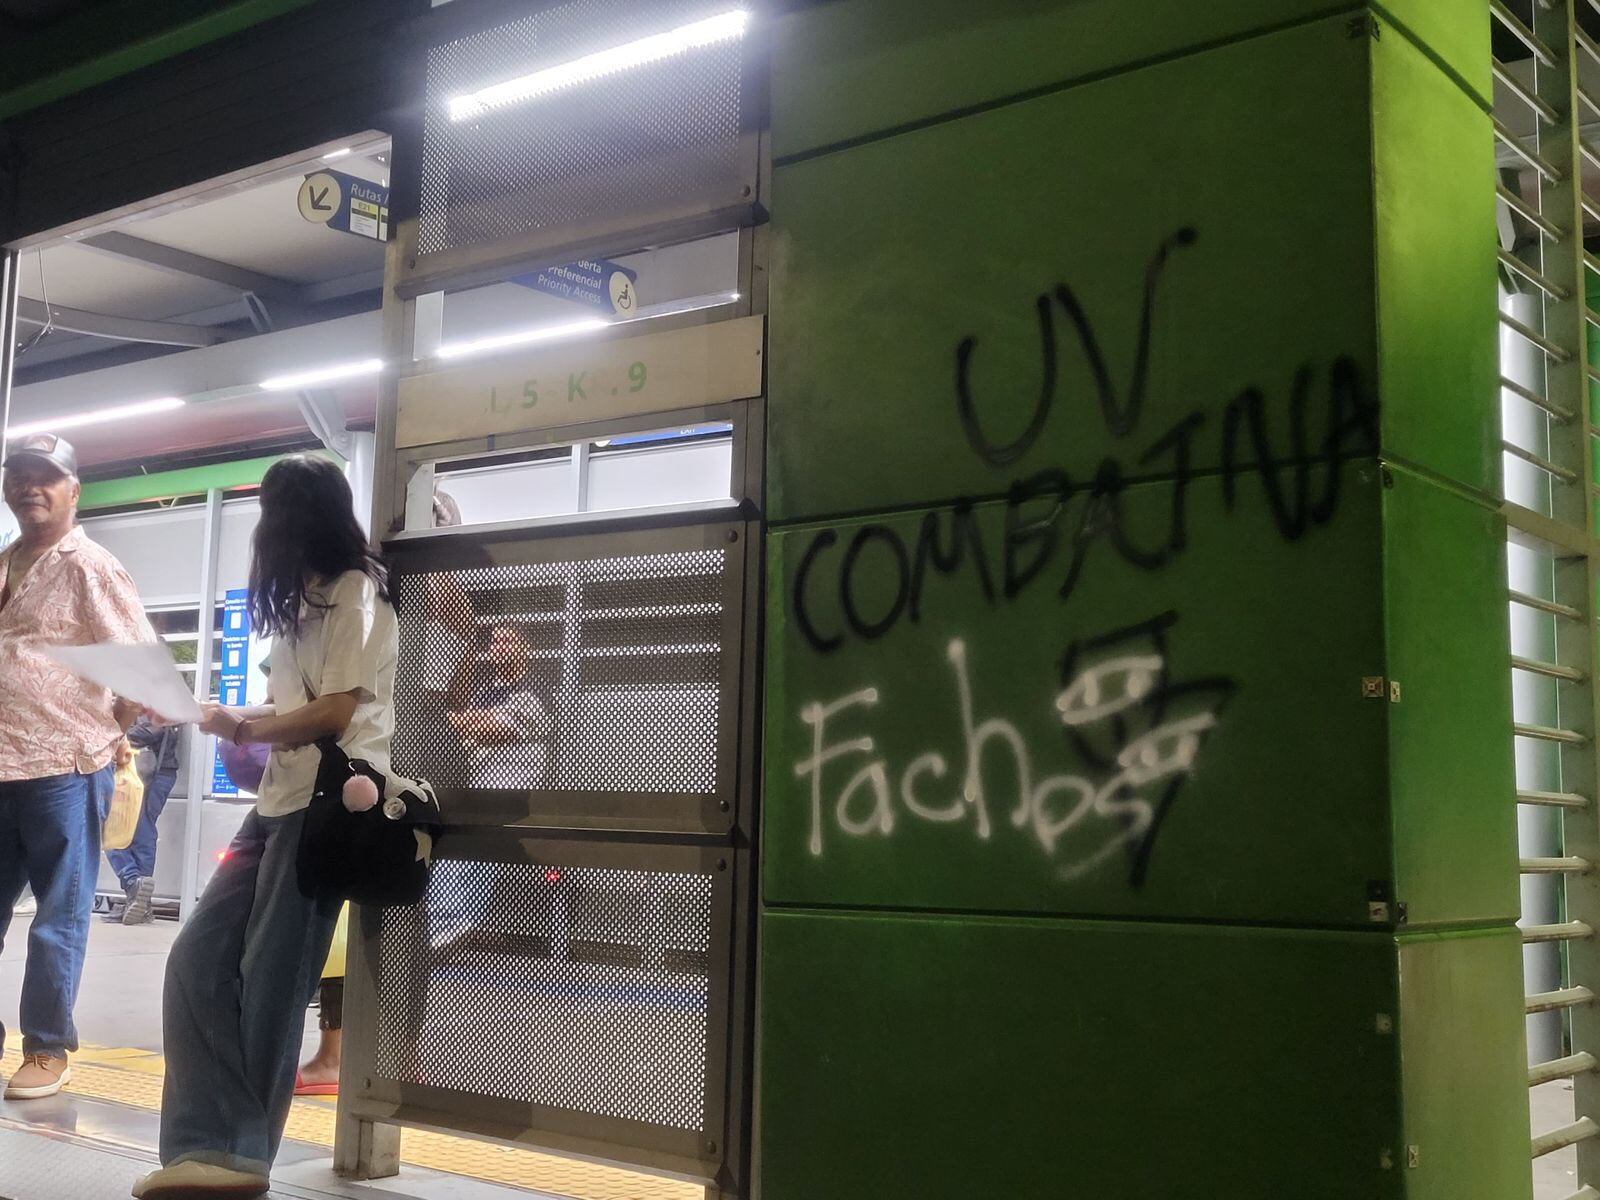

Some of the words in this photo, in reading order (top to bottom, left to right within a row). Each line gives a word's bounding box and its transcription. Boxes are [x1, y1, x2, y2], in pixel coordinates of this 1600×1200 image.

[351, 183, 381, 202] Rutas
[573, 259, 602, 274] uerta
[537, 274, 571, 297] Priority
[573, 286, 601, 304] Access
